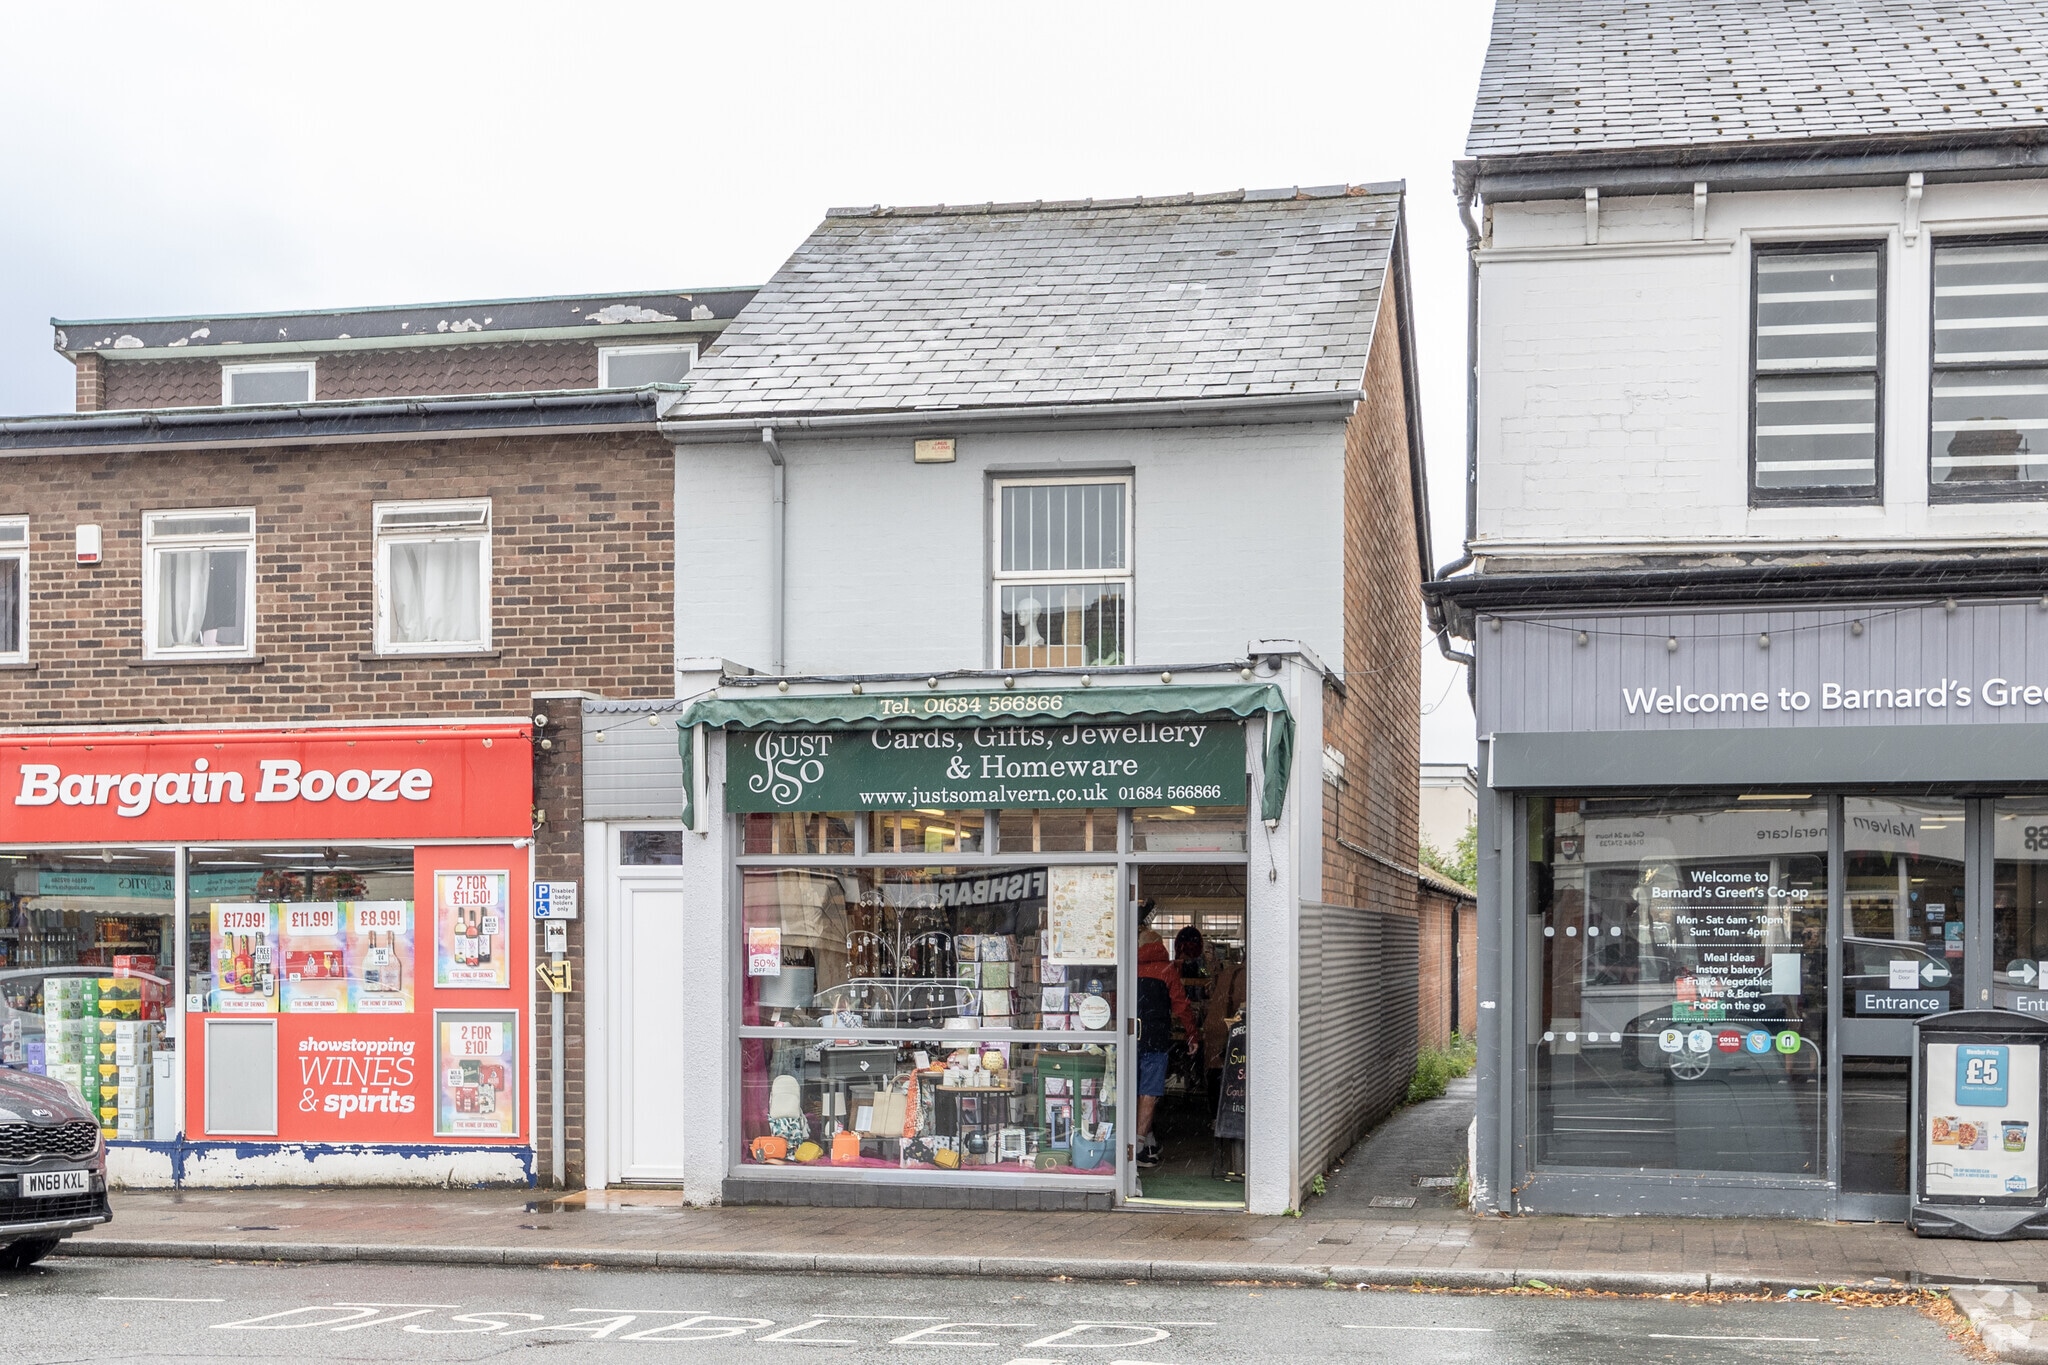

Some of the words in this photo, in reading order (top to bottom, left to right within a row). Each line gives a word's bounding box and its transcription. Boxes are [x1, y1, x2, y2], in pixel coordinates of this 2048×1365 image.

[880, 698, 916, 715] Tel.
[923, 697, 982, 714] 01684
[988, 695, 1063, 712] 566866
[1622, 685, 1769, 715] Welcome
[1778, 687, 1811, 713] to
[871, 728, 963, 752] Cards,
[973, 725, 1054, 750] Gifts,
[1062, 723, 1207, 747] Jewellery
[946, 755, 972, 780] &
[979, 754, 1139, 779] Homeware
[15, 757, 245, 818] Bargain
[254, 759, 433, 802] Booze
[859, 783, 1108, 807] www.justsomalvern.co.uk
[1118, 786, 1163, 800] 01684
[1167, 785, 1221, 799] 566866
[456, 876, 463, 889] 2
[466, 876, 487, 889] FOR
[1690, 871, 1751, 883] Welcome
[1754, 871, 1769, 882] to
[453, 890, 491, 904] £11.50!
[539, 886, 548, 898] P
[1767, 886, 1809, 900] Co-op
[224, 912, 265, 928] £17.99!
[292, 911, 333, 927] £11.99!
[360, 910, 401, 926] £8.99!
[1676, 916, 1698, 924] Mon
[1706, 916, 1724, 924] Sat:
[1726, 915, 1747, 924] 6am
[1757, 916, 1783, 926] 10pm
[1690, 928, 1710, 936] Sun:
[1713, 928, 1739, 936] 10am
[1747, 928, 1769, 938] 4pm
[754, 959, 776, 967] 50%
[1704, 953, 1728, 962] Meal
[1730, 953, 1755, 962] ideas
[1696, 966, 1729, 974] Instore
[1731, 965, 1764, 976] bakery
[1720, 977, 1773, 988] Vegetables
[1700, 989, 1724, 998] Wine
[1727, 990, 1735, 998] &
[1737, 989, 1760, 998] Beer
[1694, 1001, 1718, 1010] Food
[1734, 1001, 1750, 1010] the
[1753, 1003, 1765, 1012] go
[1865, 994, 1940, 1010] Entrance
[461, 1026, 468, 1040] 2
[471, 1026, 492, 1040] FOR
[1232, 1026, 1246, 1037] SPEC
[298, 1036, 416, 1056] showstopping
[465, 1041, 488, 1054] £10!
[298, 1056, 415, 1086] WINES
[1966, 1058, 1998, 1085] £5
[298, 1088, 319, 1112] &
[323, 1087, 416, 1119] spirits
[29, 1175, 60, 1192] WN68
[64, 1173, 84, 1189] KXL
[209, 1306, 1176, 1348] DISABLED
